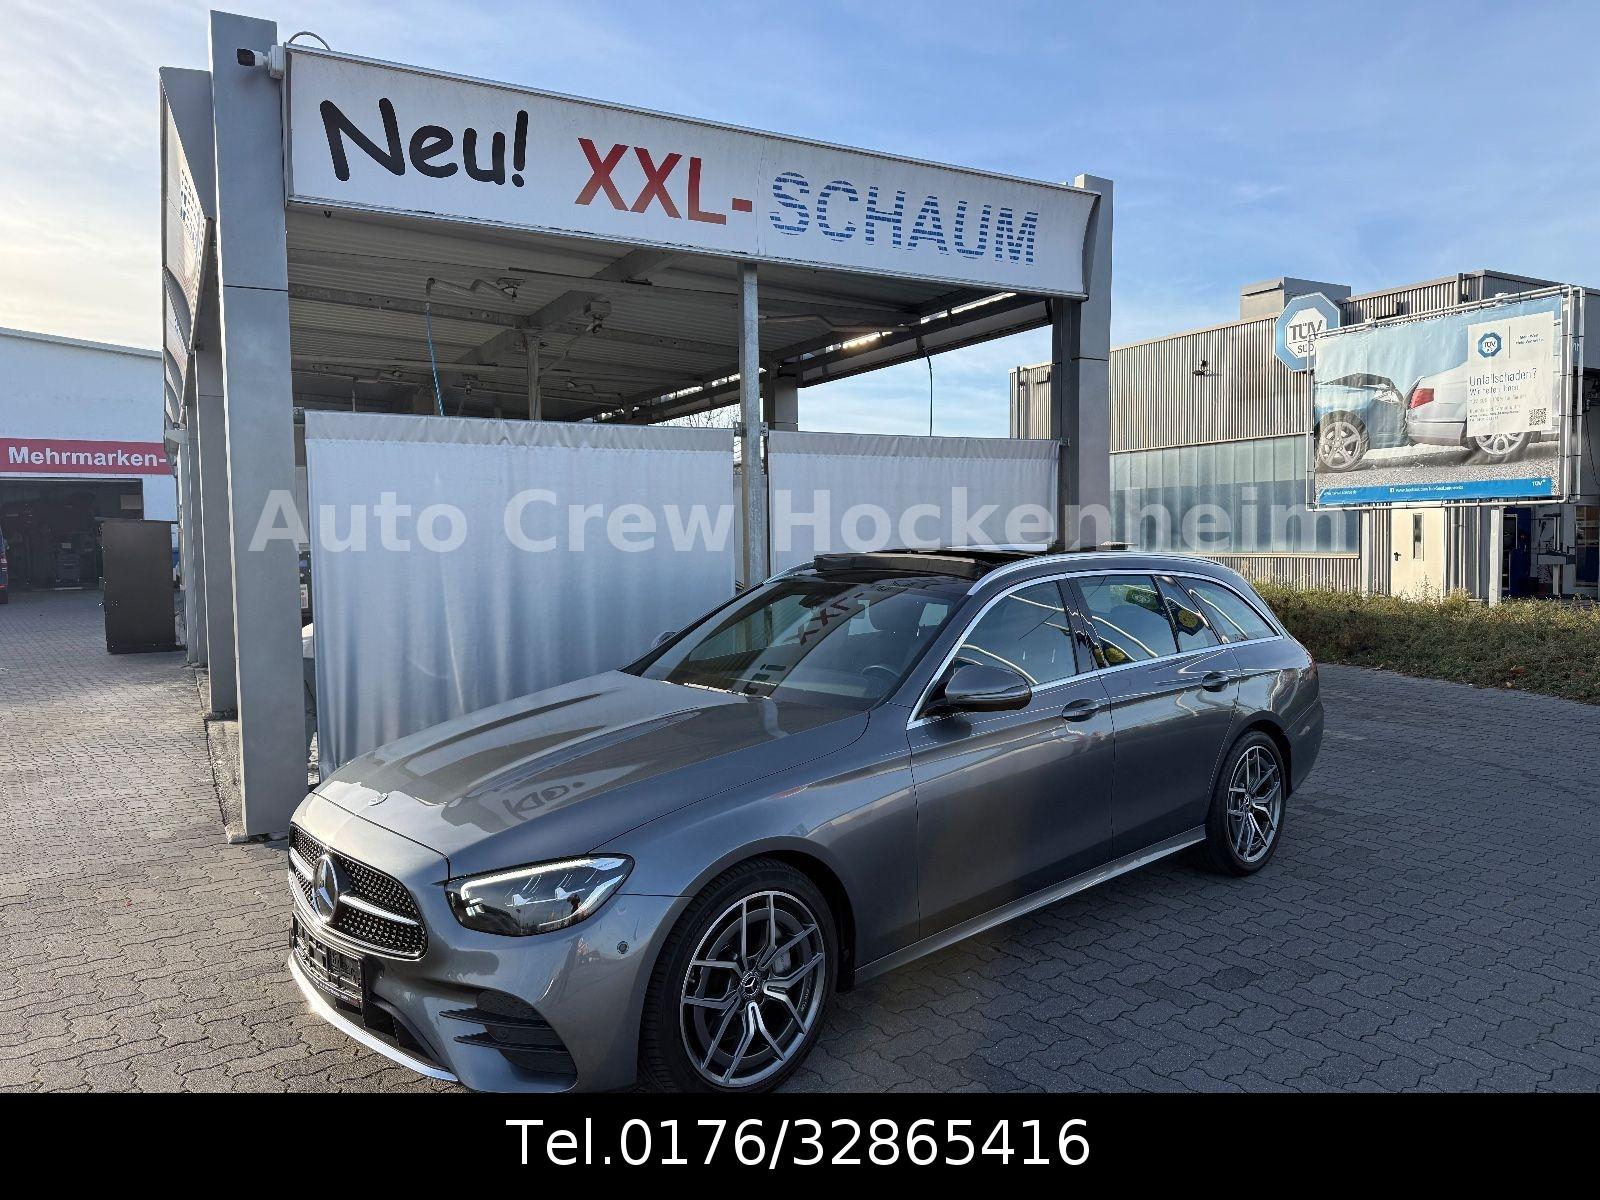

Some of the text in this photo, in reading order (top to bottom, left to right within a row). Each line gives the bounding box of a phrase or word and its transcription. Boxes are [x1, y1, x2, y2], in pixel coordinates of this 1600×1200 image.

[319, 98, 529, 188] Neu!
[1289, 319, 1323, 341] TÜV
[1469, 367, 1537, 387] Unfallschaden?
[8, 446, 167, 467] Mehrmarken-
